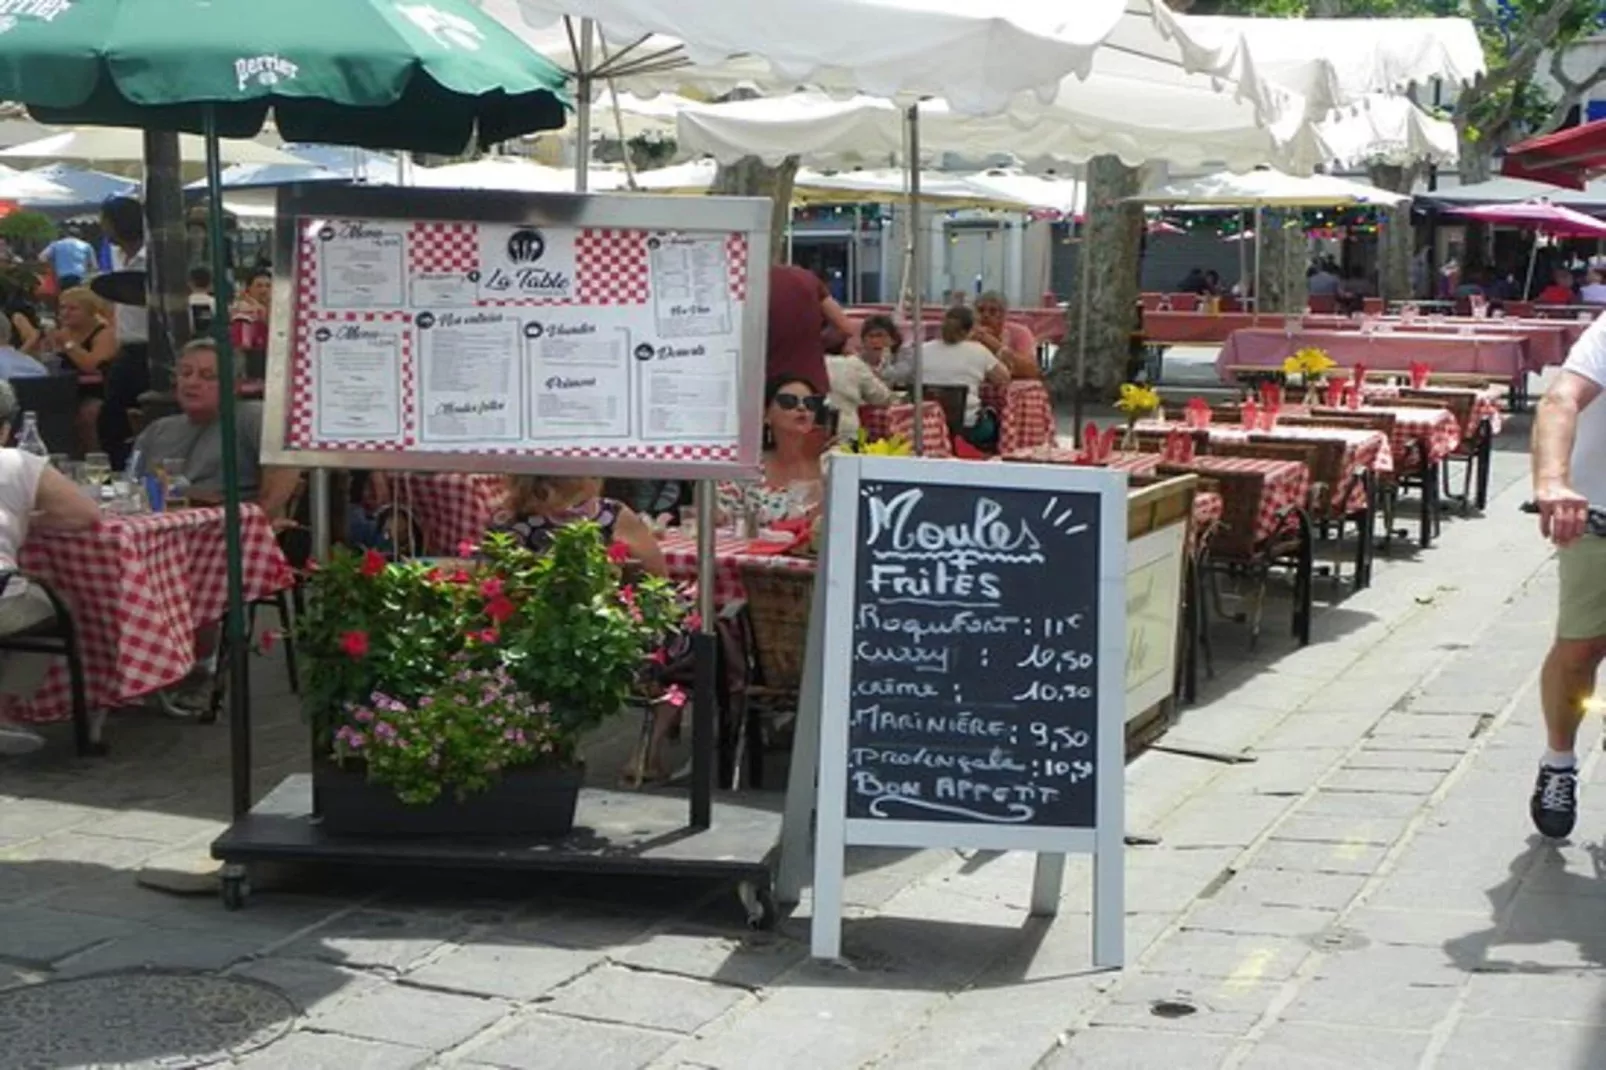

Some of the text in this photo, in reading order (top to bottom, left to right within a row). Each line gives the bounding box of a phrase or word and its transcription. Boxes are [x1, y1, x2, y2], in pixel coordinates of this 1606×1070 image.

[484, 267, 511, 292] La
[516, 267, 570, 289] Table
[866, 488, 1041, 551] Moules
